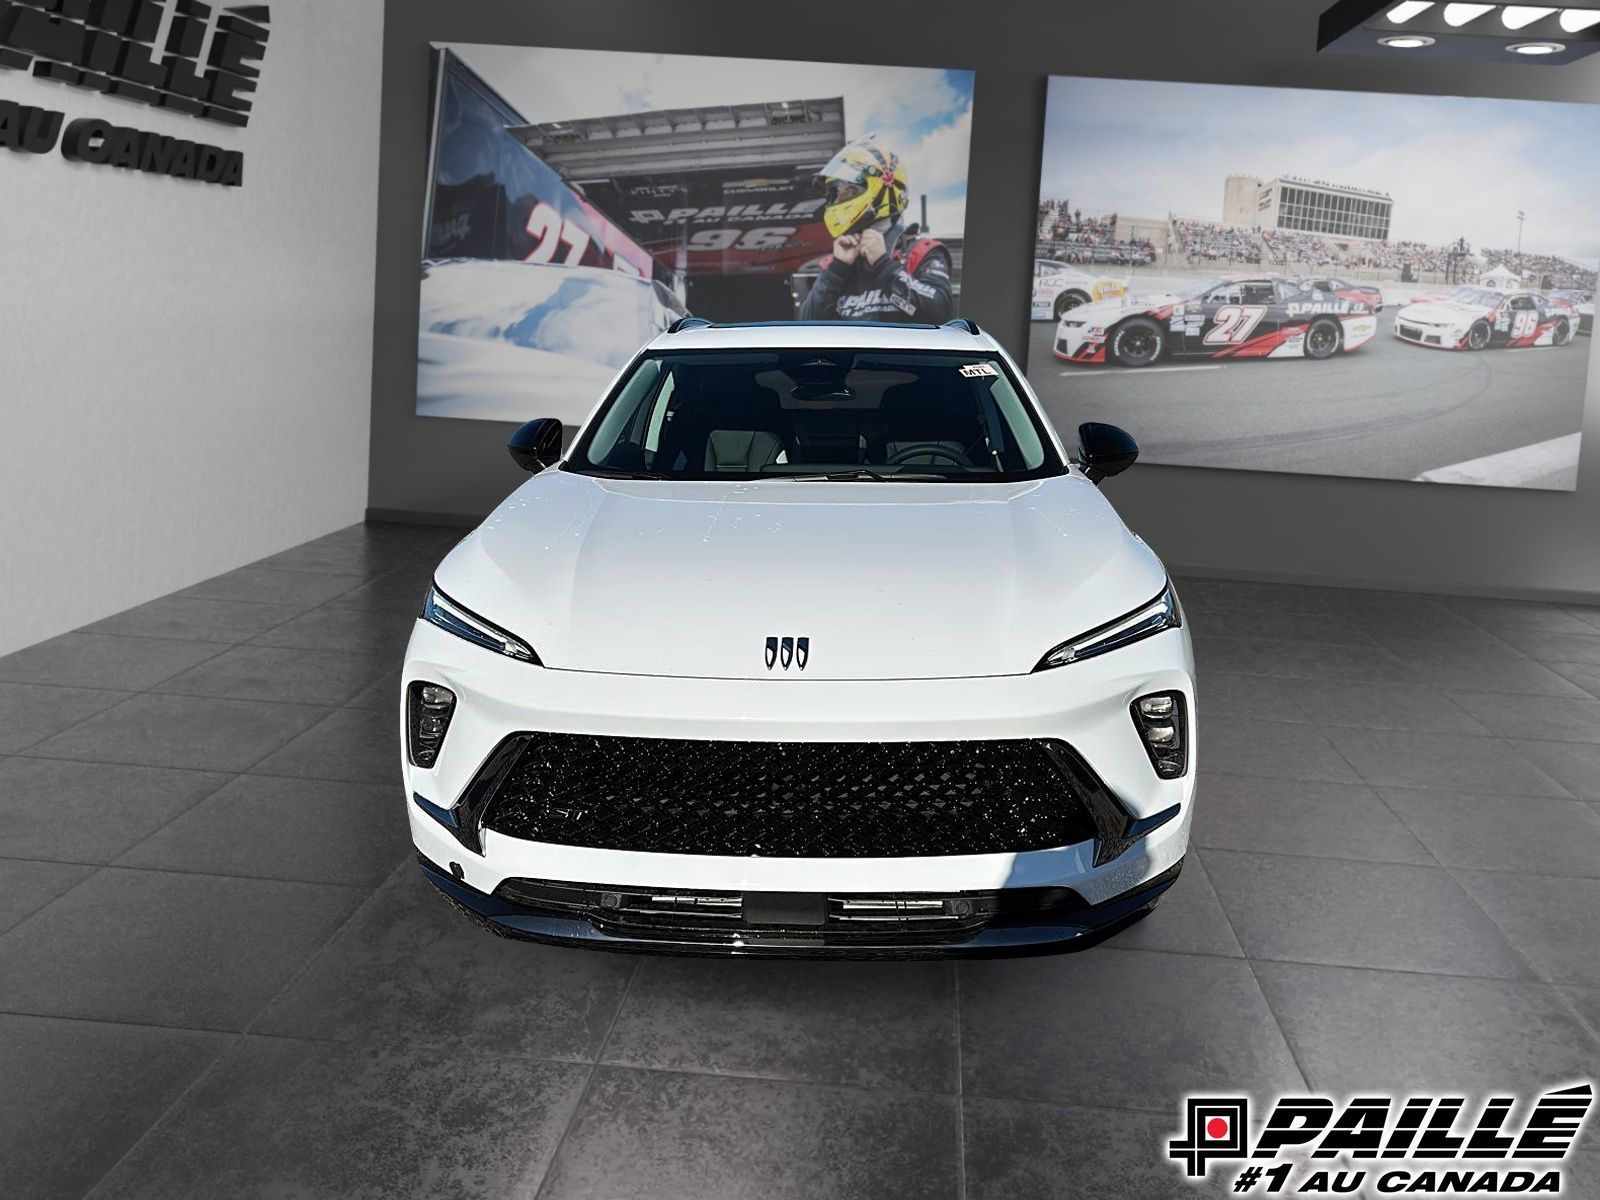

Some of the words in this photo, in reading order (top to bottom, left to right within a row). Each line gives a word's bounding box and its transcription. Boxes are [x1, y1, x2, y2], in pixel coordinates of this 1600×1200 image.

[61, 118, 243, 187] CANADA
[524, 200, 590, 266] 27
[687, 227, 797, 250] 96
[1203, 305, 1267, 345] 27
[1513, 311, 1538, 337] 96
